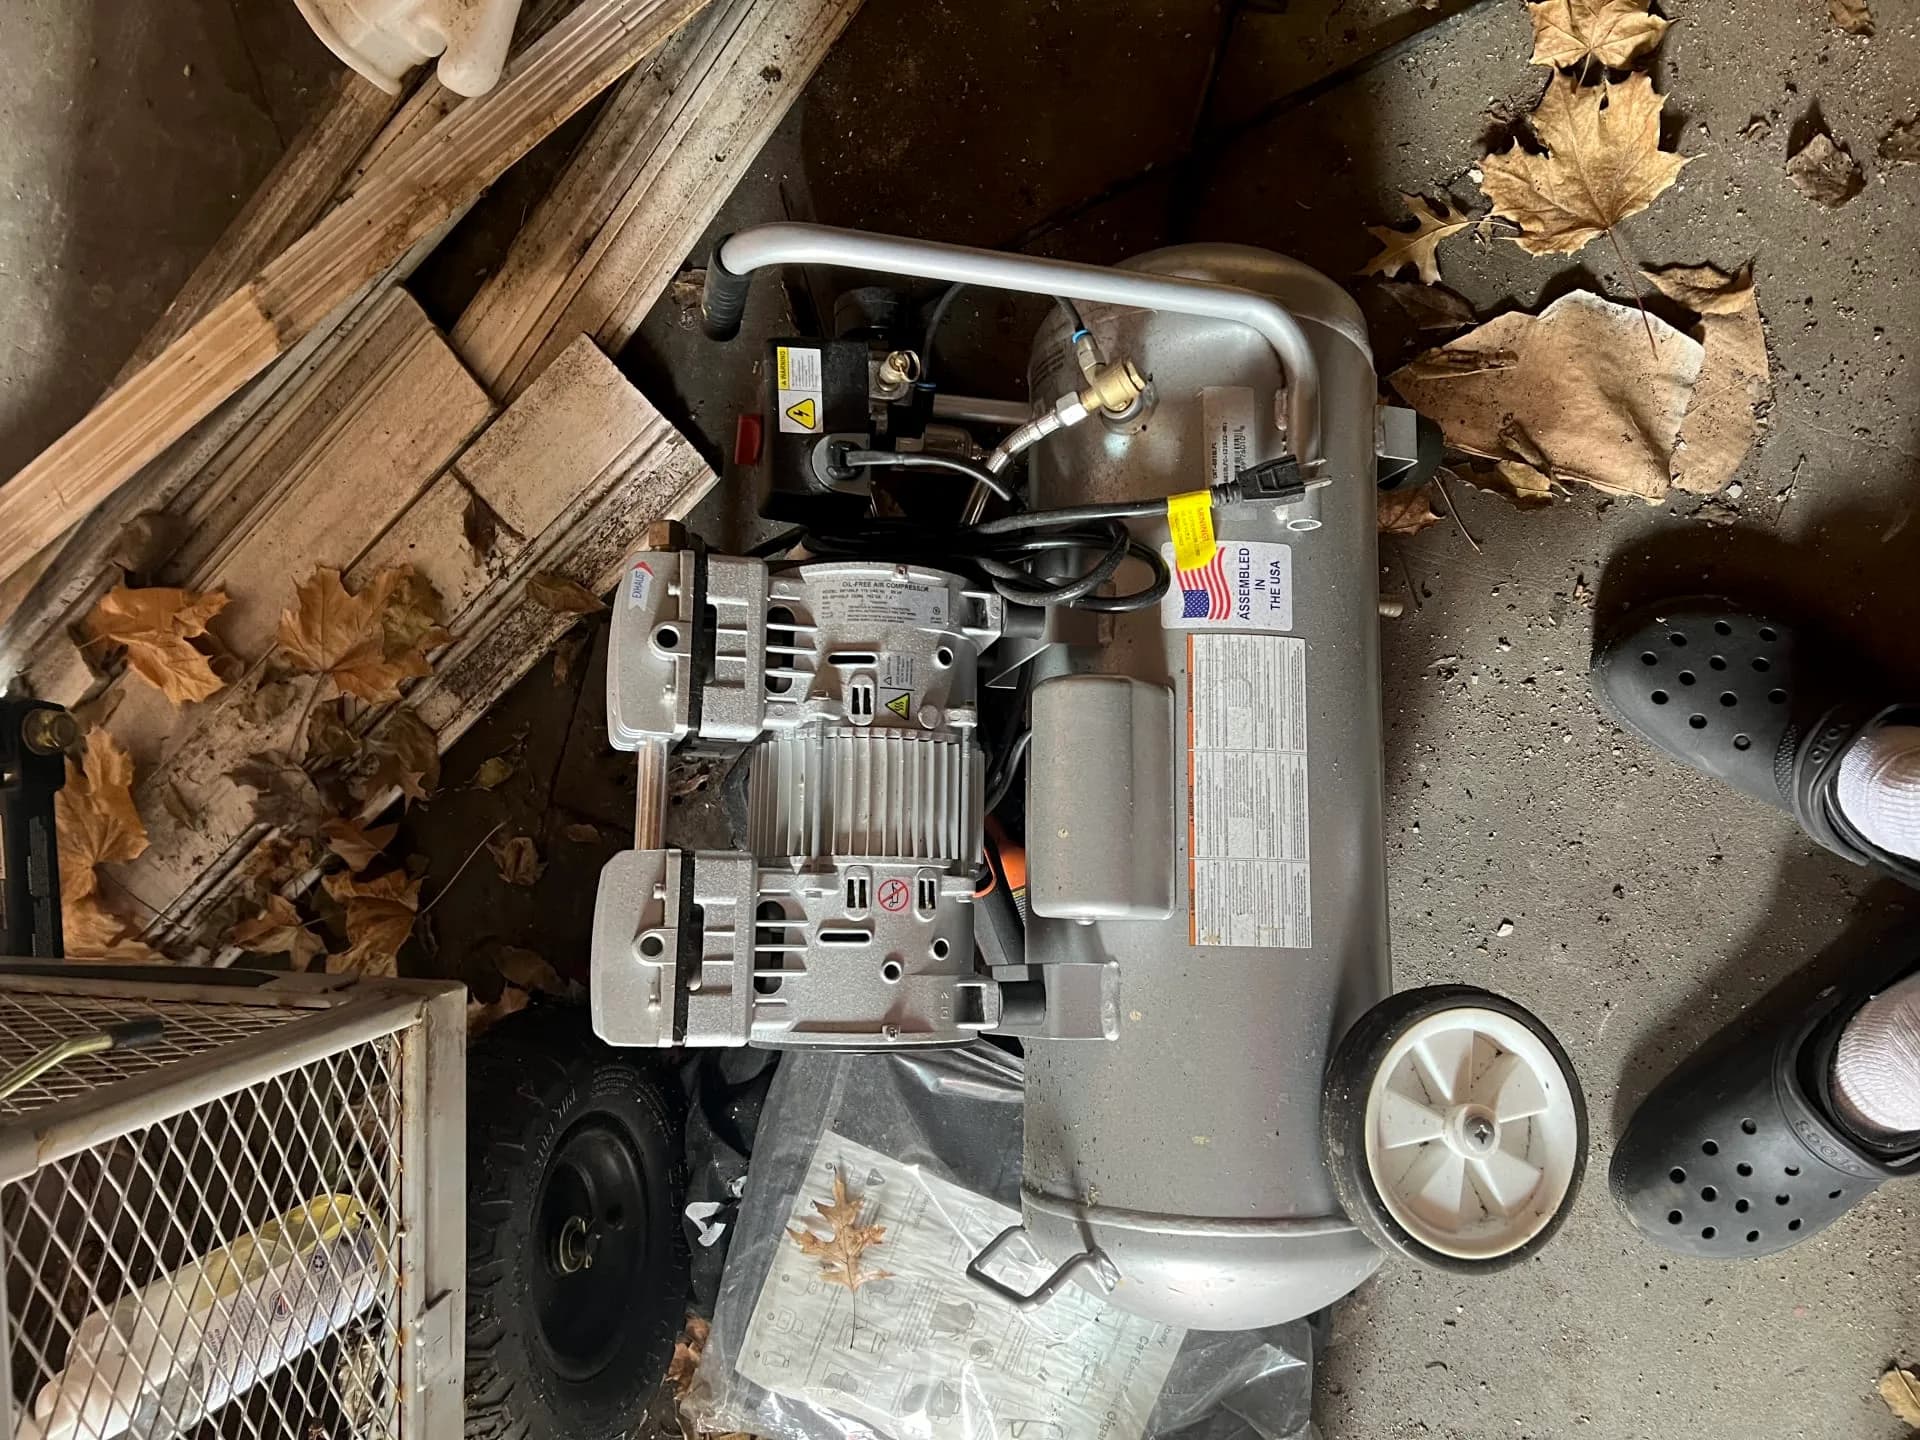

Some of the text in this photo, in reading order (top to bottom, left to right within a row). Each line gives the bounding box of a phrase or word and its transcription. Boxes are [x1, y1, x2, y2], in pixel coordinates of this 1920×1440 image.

[886, 582, 929, 592] COMPRESSOR
[1238, 547, 1250, 620] ASSEMBLED
[1254, 579, 1266, 591] IN
[1270, 560, 1281, 611] THE USA
[1134, 1335, 1150, 1356] Car
